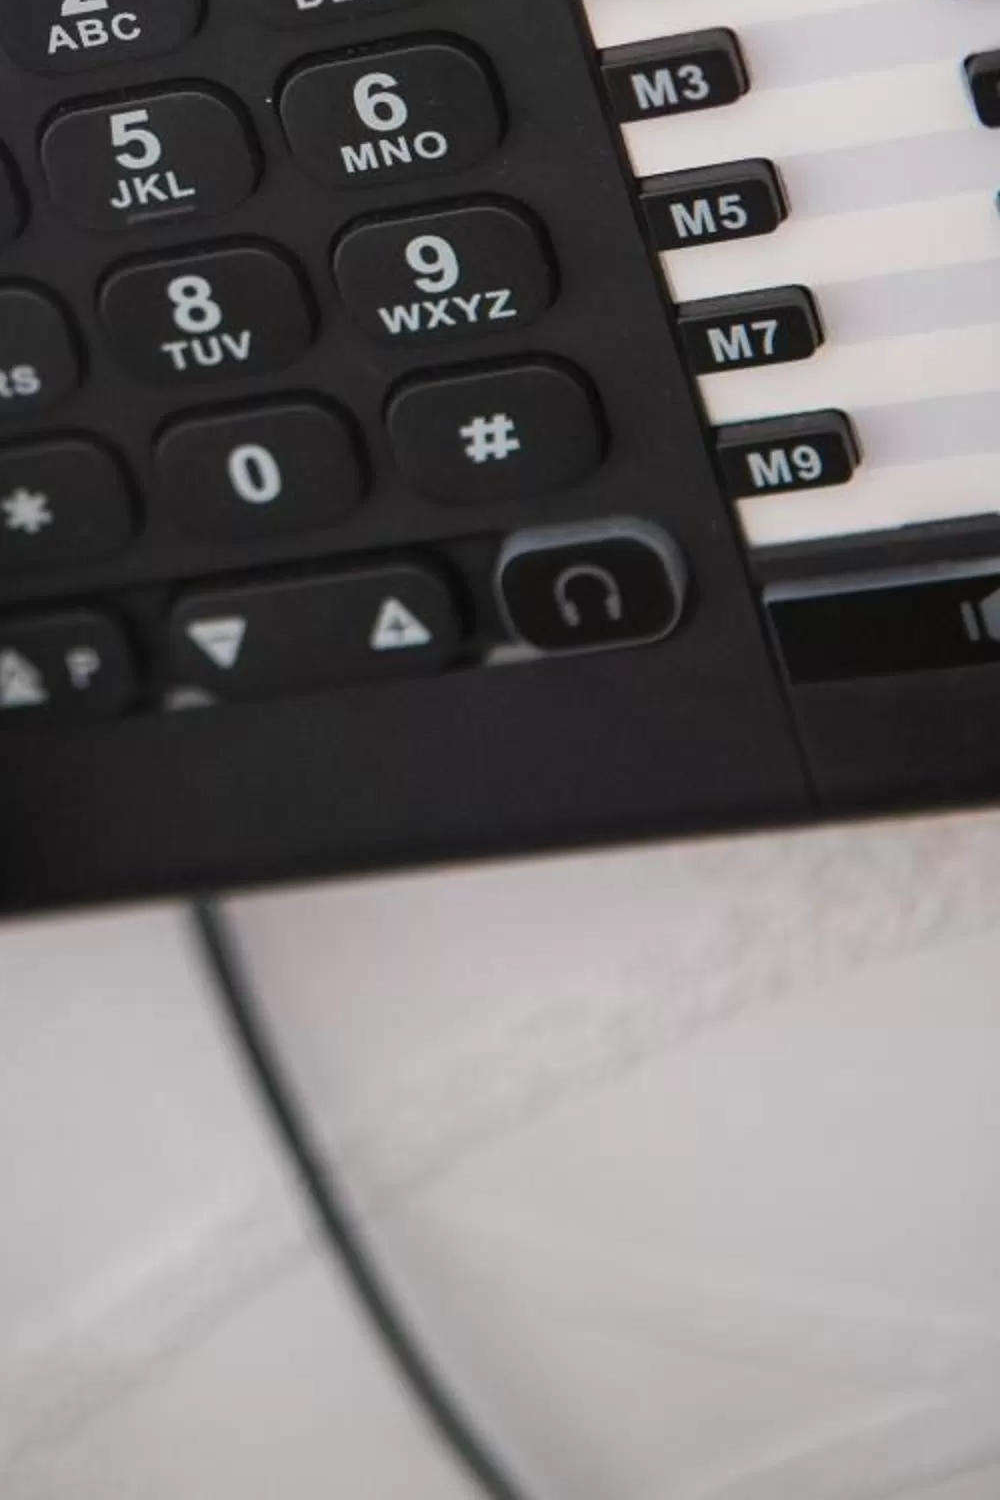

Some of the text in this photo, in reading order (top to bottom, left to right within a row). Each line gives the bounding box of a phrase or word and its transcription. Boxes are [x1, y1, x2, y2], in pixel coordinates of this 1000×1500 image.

[48, 12, 141, 54] ABC
[353, 72, 408, 132] 6
[631, 64, 710, 110] M3
[109, 109, 162, 170] 5
[340, 131, 448, 173] MNO
[110, 171, 196, 209] JKL
[669, 194, 749, 241] M5
[405, 235, 459, 294] 9
[167, 275, 222, 333] 8
[377, 289, 517, 334] WXYZ
[161, 331, 252, 371] TUV
[706, 319, 780, 364] M7
[459, 413, 521, 463] #
[228, 444, 282, 503] 0
[747, 445, 823, 489] M9
